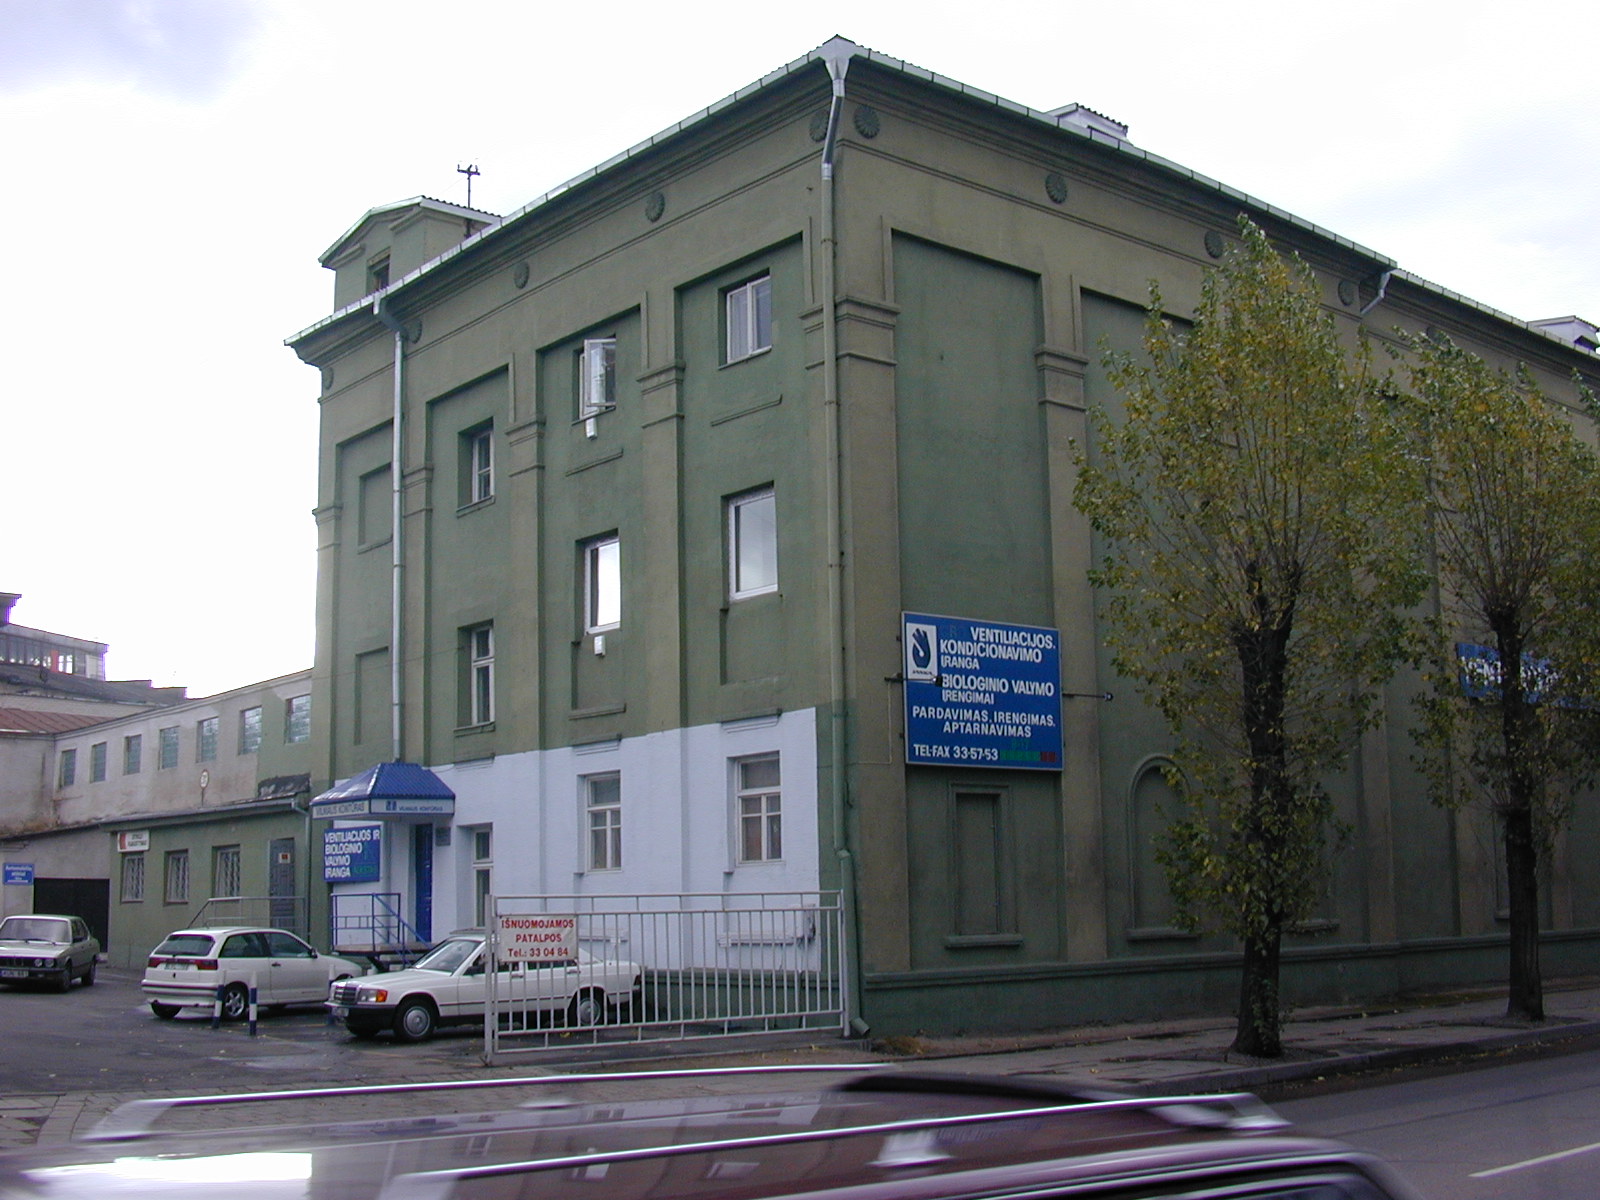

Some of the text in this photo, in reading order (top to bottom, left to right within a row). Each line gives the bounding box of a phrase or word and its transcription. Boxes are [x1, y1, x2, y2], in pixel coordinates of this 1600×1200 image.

[940, 639, 1042, 663] KONDICIONAVIMO
[941, 673, 1054, 697] BIOLOGINIO VALYMO
[943, 721, 1032, 738] APTARNAVIMAS
[372, 829, 380, 840] IR
[324, 842, 363, 855] BIOLOGINIO
[324, 854, 351, 867] VALYMO
[501, 918, 574, 929] IŠNUOMOJAMOS
[515, 933, 562, 943] PATALPOS
[529, 948, 541, 957] 33
[543, 947, 555, 956] 04
[557, 947, 569, 956] 84
